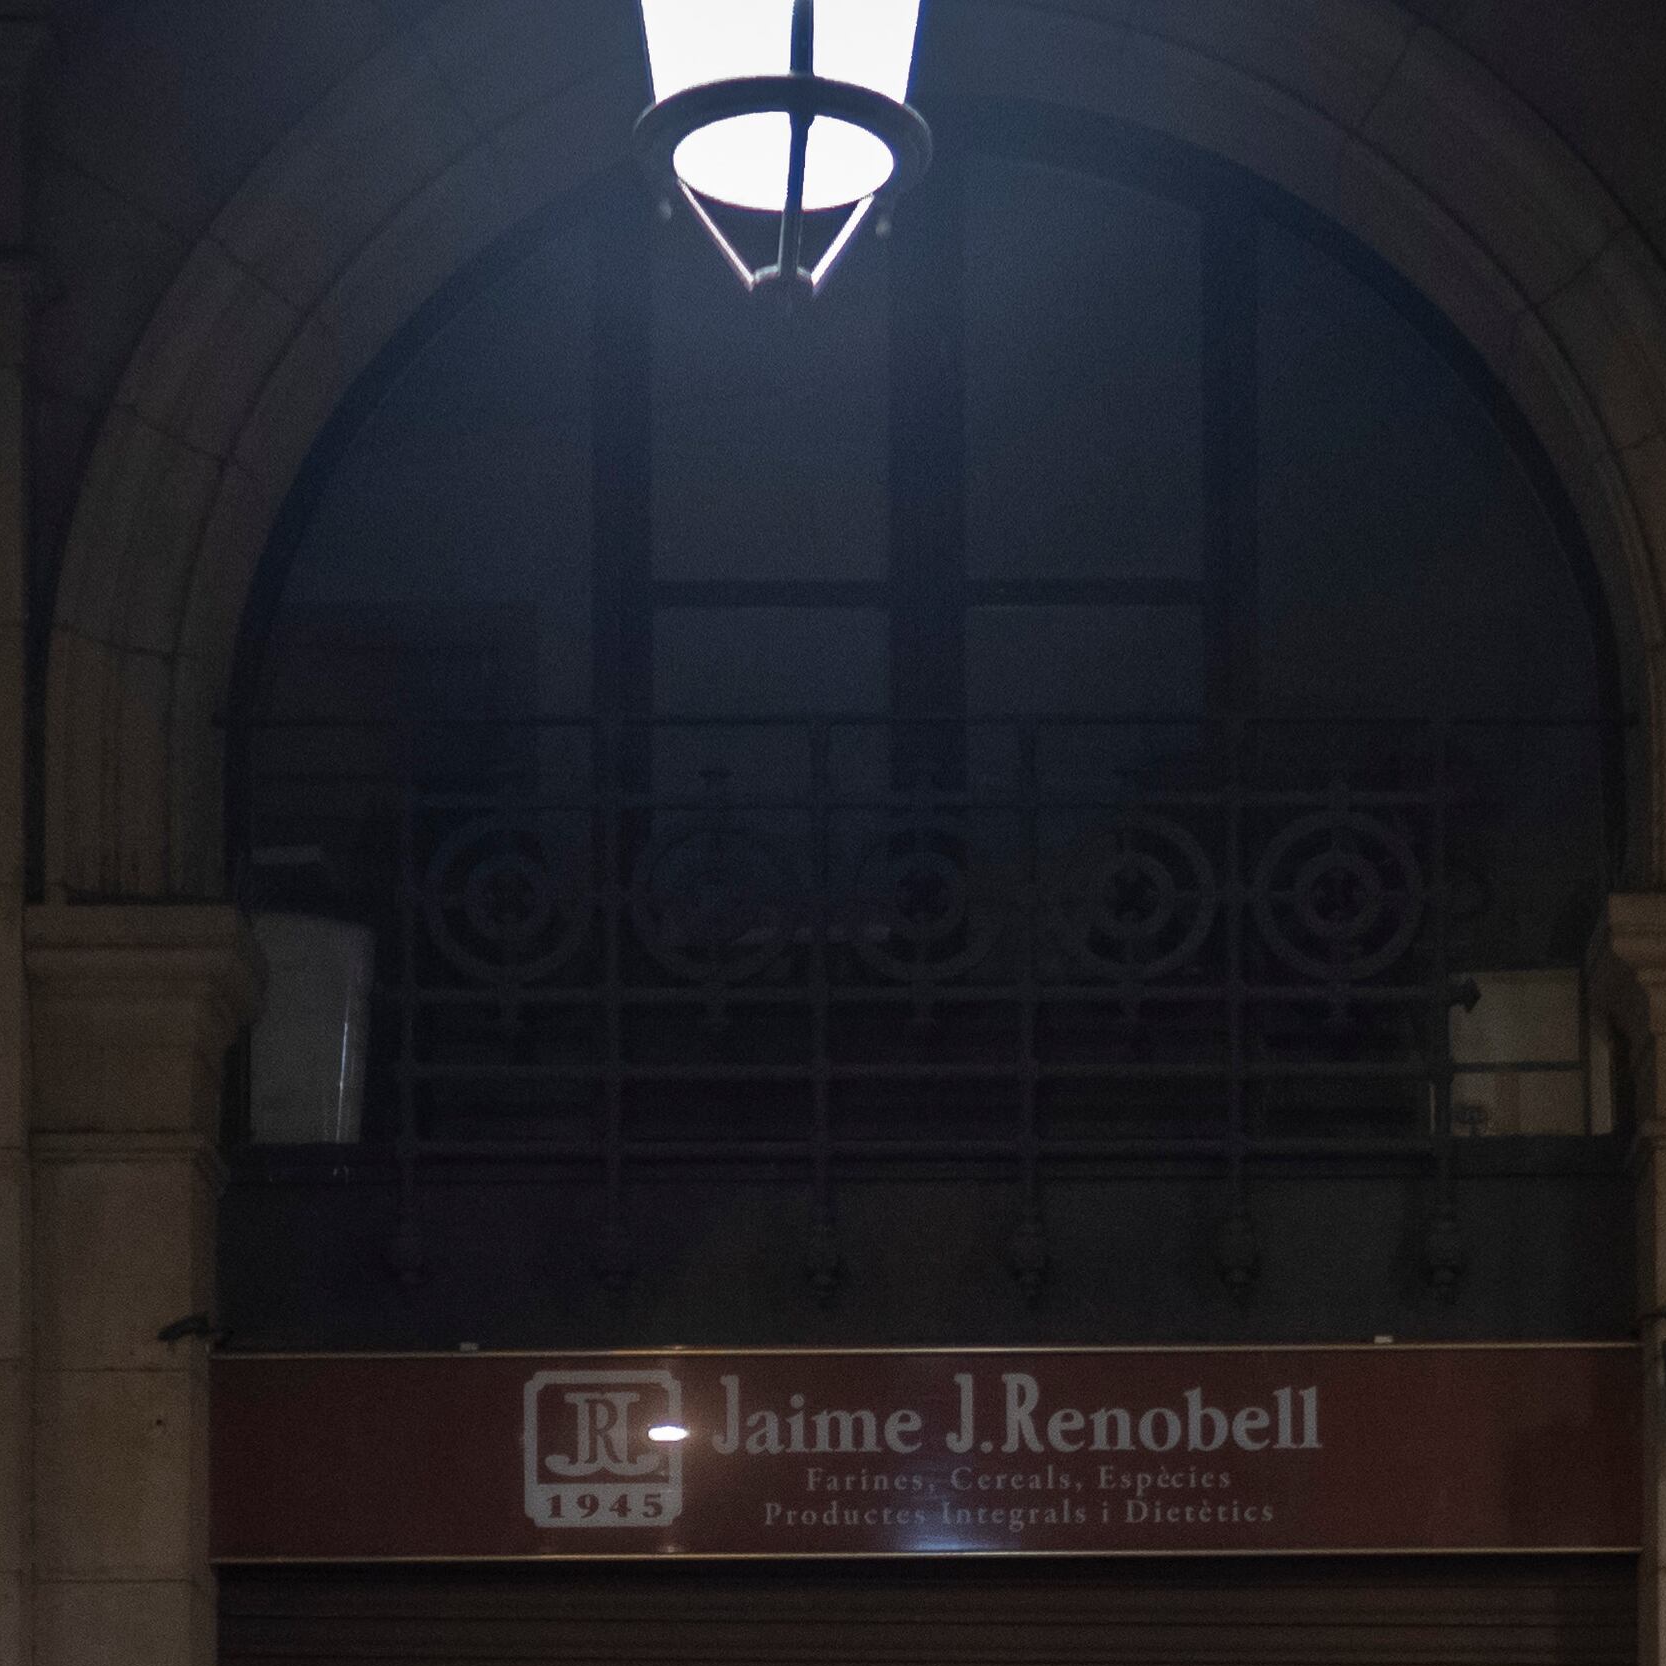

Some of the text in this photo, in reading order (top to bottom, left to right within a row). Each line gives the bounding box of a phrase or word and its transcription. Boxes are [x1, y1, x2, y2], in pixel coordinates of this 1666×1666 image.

[712, 1374, 923, 1455] Jaime
[806, 1464, 1233, 1498] Farines, Cereals, Espècies
[546, 1492, 665, 1520] 1945
[765, 1498, 1275, 1533] Productes Integrals i Dietètics
